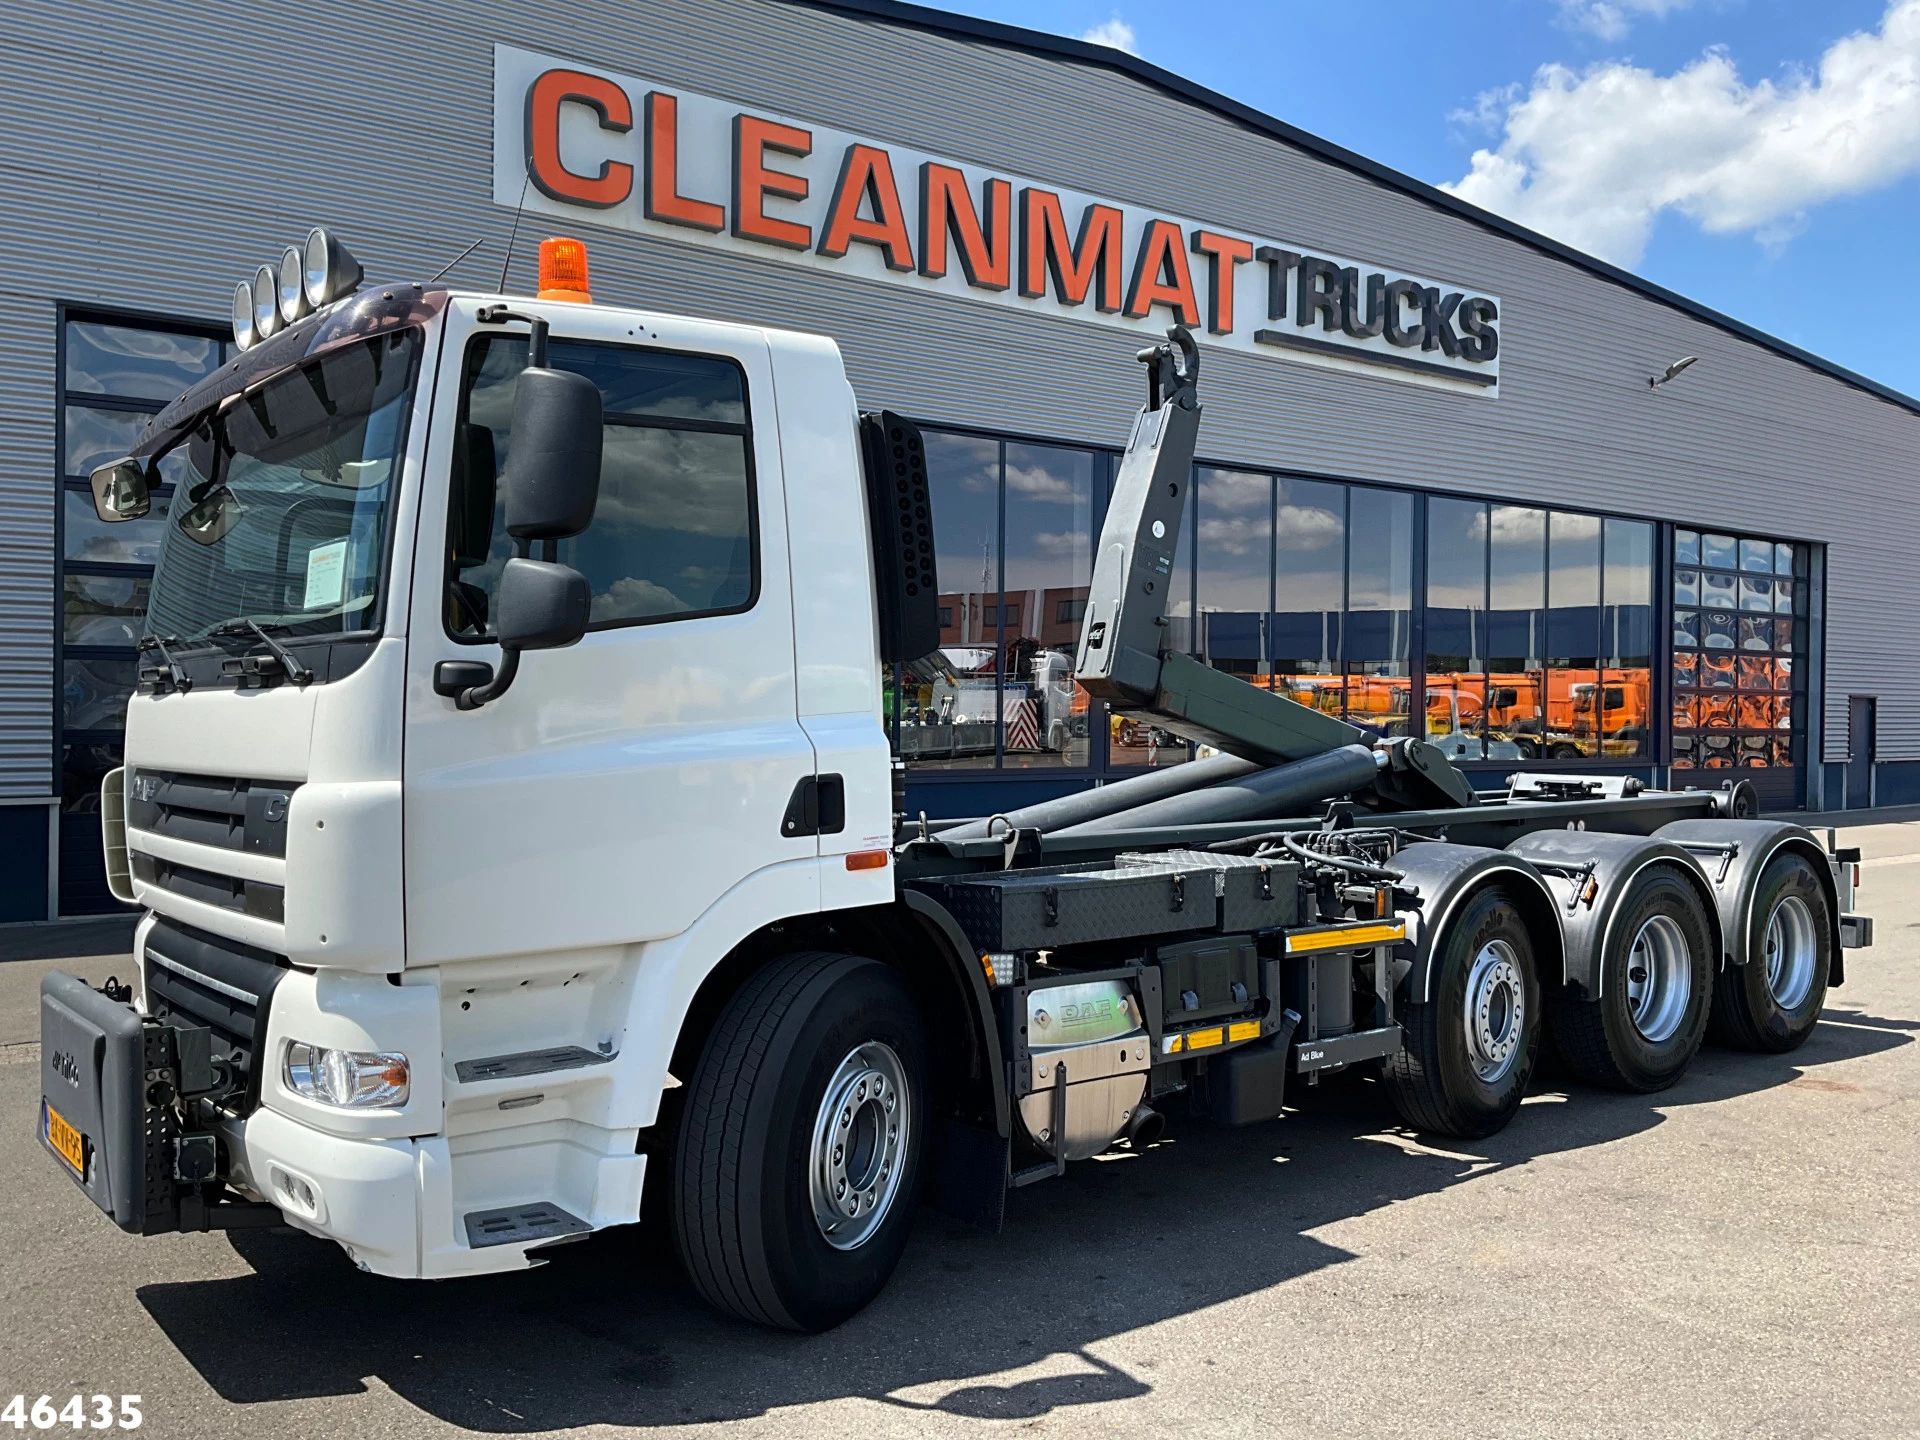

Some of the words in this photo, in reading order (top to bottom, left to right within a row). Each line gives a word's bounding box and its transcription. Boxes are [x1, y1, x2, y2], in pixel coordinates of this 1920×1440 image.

[524, 68, 1253, 335] CLEANMAT
[1256, 245, 1498, 363] TRUCKS
[1060, 999, 1111, 1020] DAF
[1300, 1052, 1310, 1062] Ad
[1310, 1050, 1324, 1060] Blue
